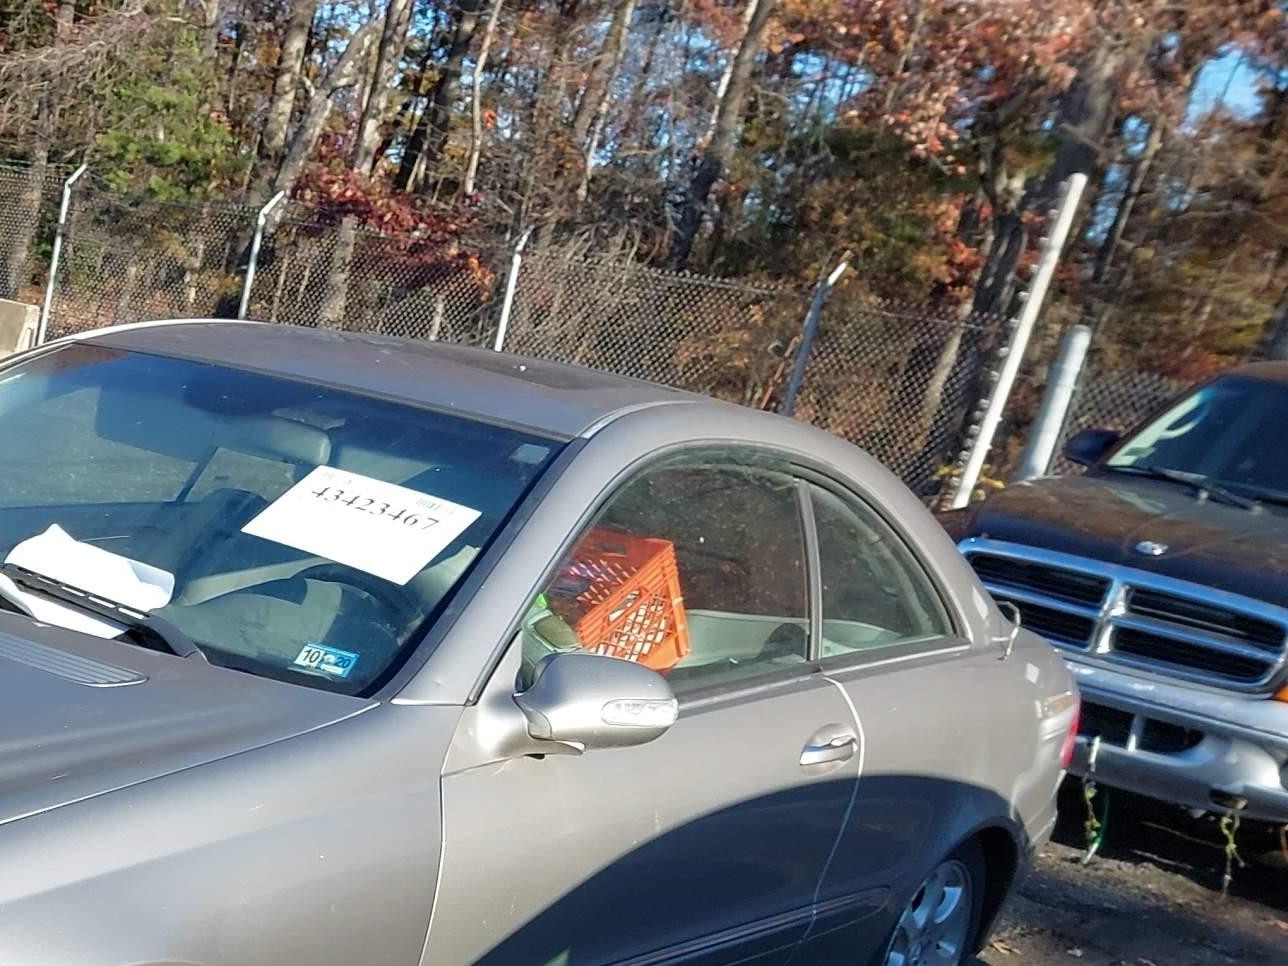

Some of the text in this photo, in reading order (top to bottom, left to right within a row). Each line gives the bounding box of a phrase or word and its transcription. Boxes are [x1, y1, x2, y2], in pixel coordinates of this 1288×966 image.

[312, 486, 440, 530] 43423467
[302, 648, 352, 669] 10 20
